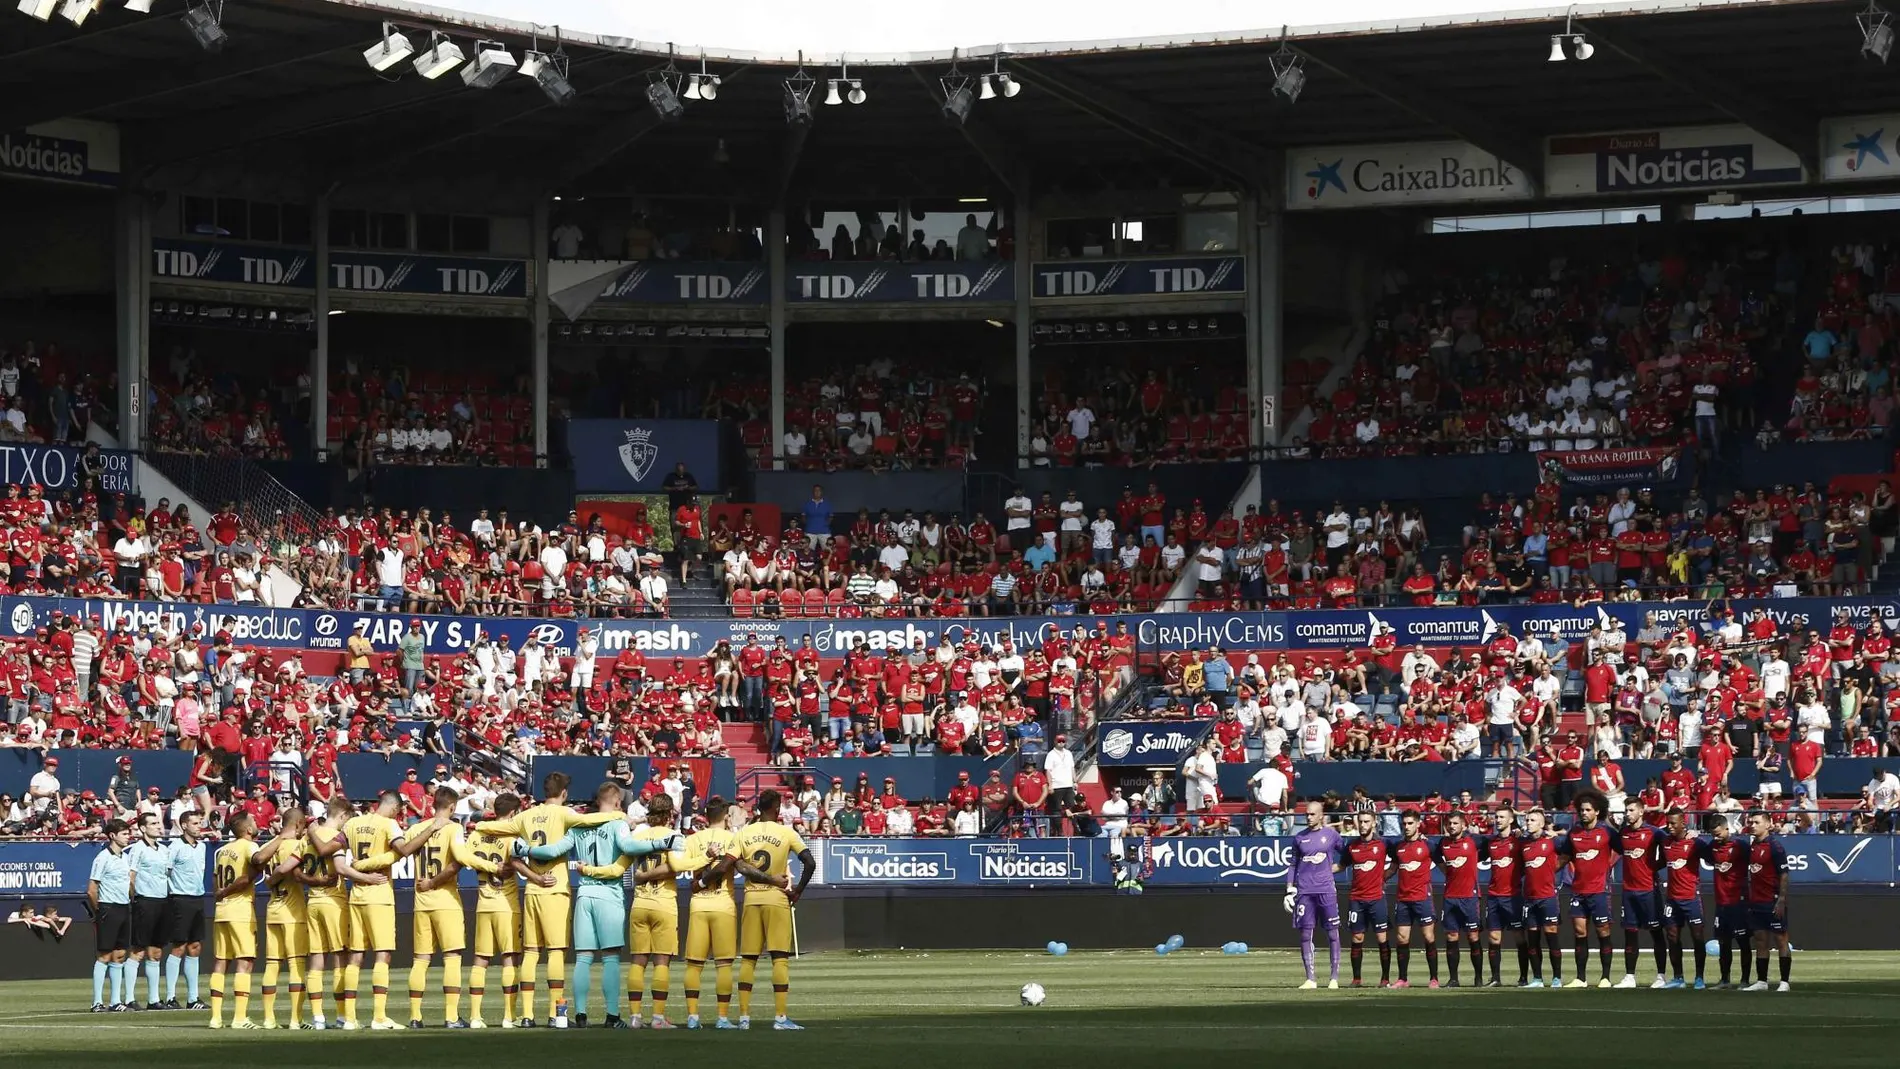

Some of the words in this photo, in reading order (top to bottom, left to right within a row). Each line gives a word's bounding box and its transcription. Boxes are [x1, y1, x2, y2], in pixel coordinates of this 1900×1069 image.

[0, 134, 83, 176] Noticias
[1353, 157, 1514, 193] CaixaBank
[1608, 150, 1745, 186] Noticias
[154, 250, 198, 277] TID
[240, 257, 283, 284] TID
[331, 264, 385, 290] TID
[436, 268, 489, 294] TID
[674, 275, 731, 298] TID
[796, 275, 855, 298] TID
[911, 274, 971, 298] TID
[1040, 271, 1096, 295] TID
[1149, 268, 1206, 292] TID
[74, 453, 128, 471] ADOR
[1566, 454, 1577, 465] LA
[1580, 453, 1609, 464] RANA
[1613, 472, 1653, 480] SALAMANA
[358, 617, 440, 645] ZARY
[604, 624, 690, 650] mash
[729, 622, 780, 631] almohadas
[835, 623, 926, 650] mash
[310, 637, 342, 648] HYUNDAI
[753, 835, 781, 848] SEMEDO
[850, 845, 874, 854] Diario
[875, 846, 884, 854] de
[987, 844, 1008, 854] Diario
[1009, 845, 1016, 853] de
[1177, 839, 1293, 867] lacturale
[417, 846, 443, 881] 15
[589, 841, 597, 867] 1
[750, 850, 772, 873] 2
[849, 855, 939, 877] Noticias
[985, 855, 1068, 877] Noticias
[28, 862, 34, 870] Y
[35, 862, 55, 871] OBRAS
[25, 871, 62, 888] VICENTE
